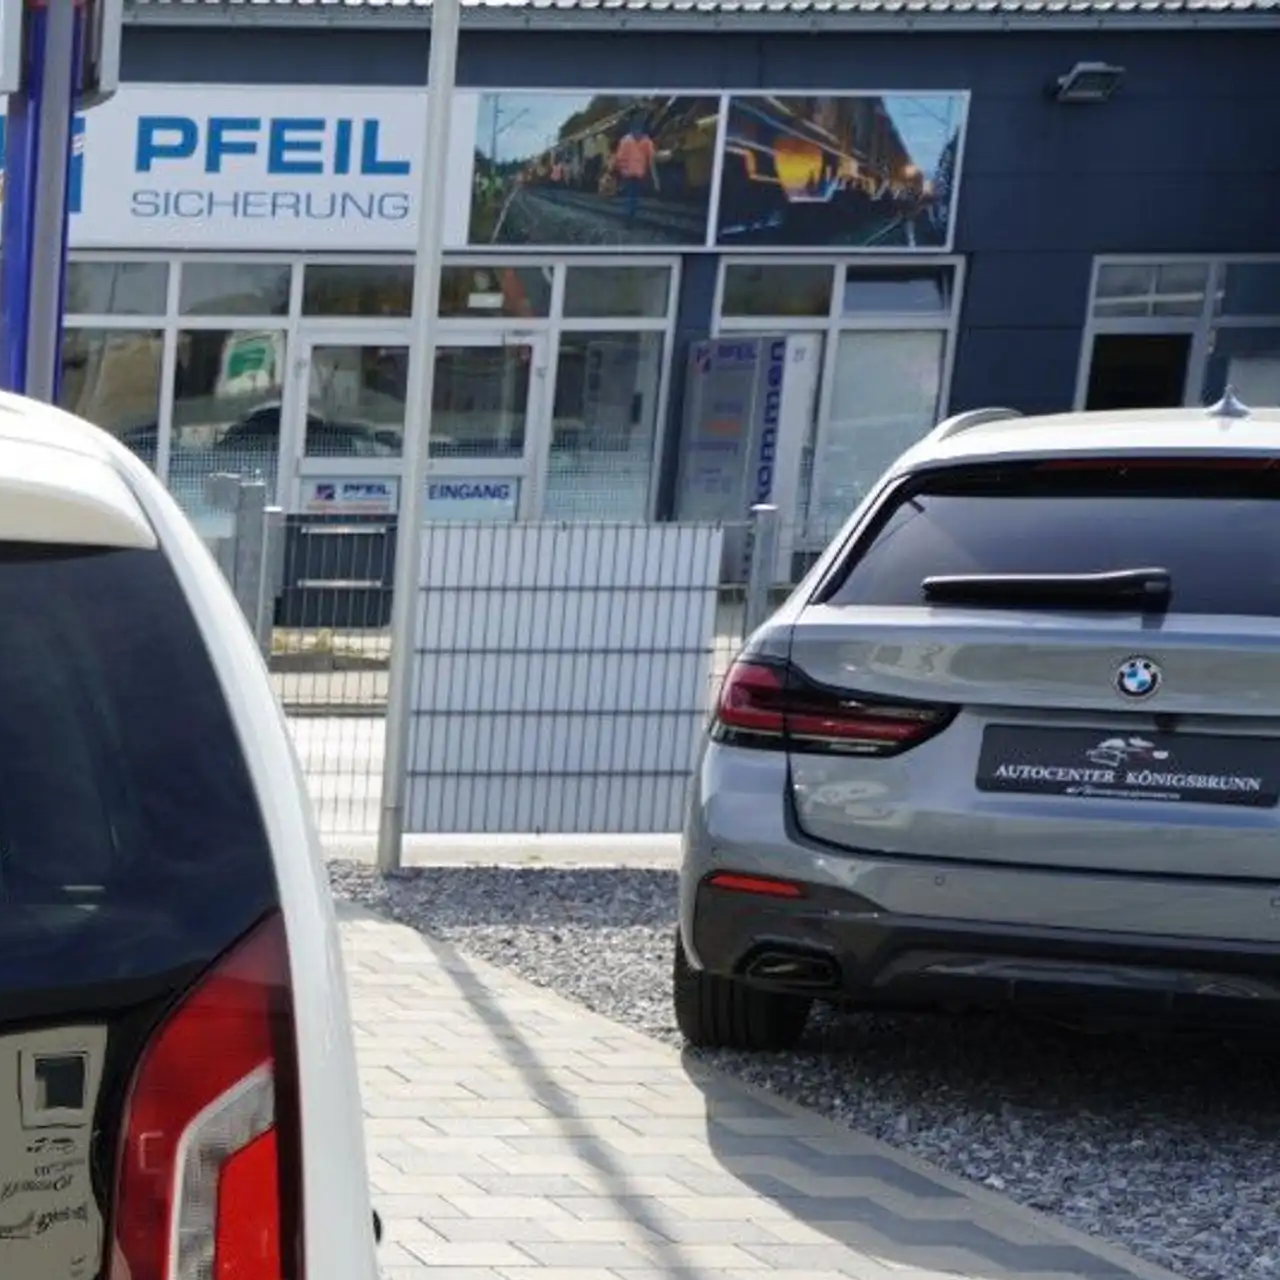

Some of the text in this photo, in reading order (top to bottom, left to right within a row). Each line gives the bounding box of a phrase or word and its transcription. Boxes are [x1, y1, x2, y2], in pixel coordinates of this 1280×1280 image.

[135, 116, 411, 175] PFEIL
[131, 189, 410, 219] SICHERUNG
[428, 483, 510, 500] EINGANG
[995, 764, 1261, 790] AUTOCENTER KÖNIGSBRUNN
